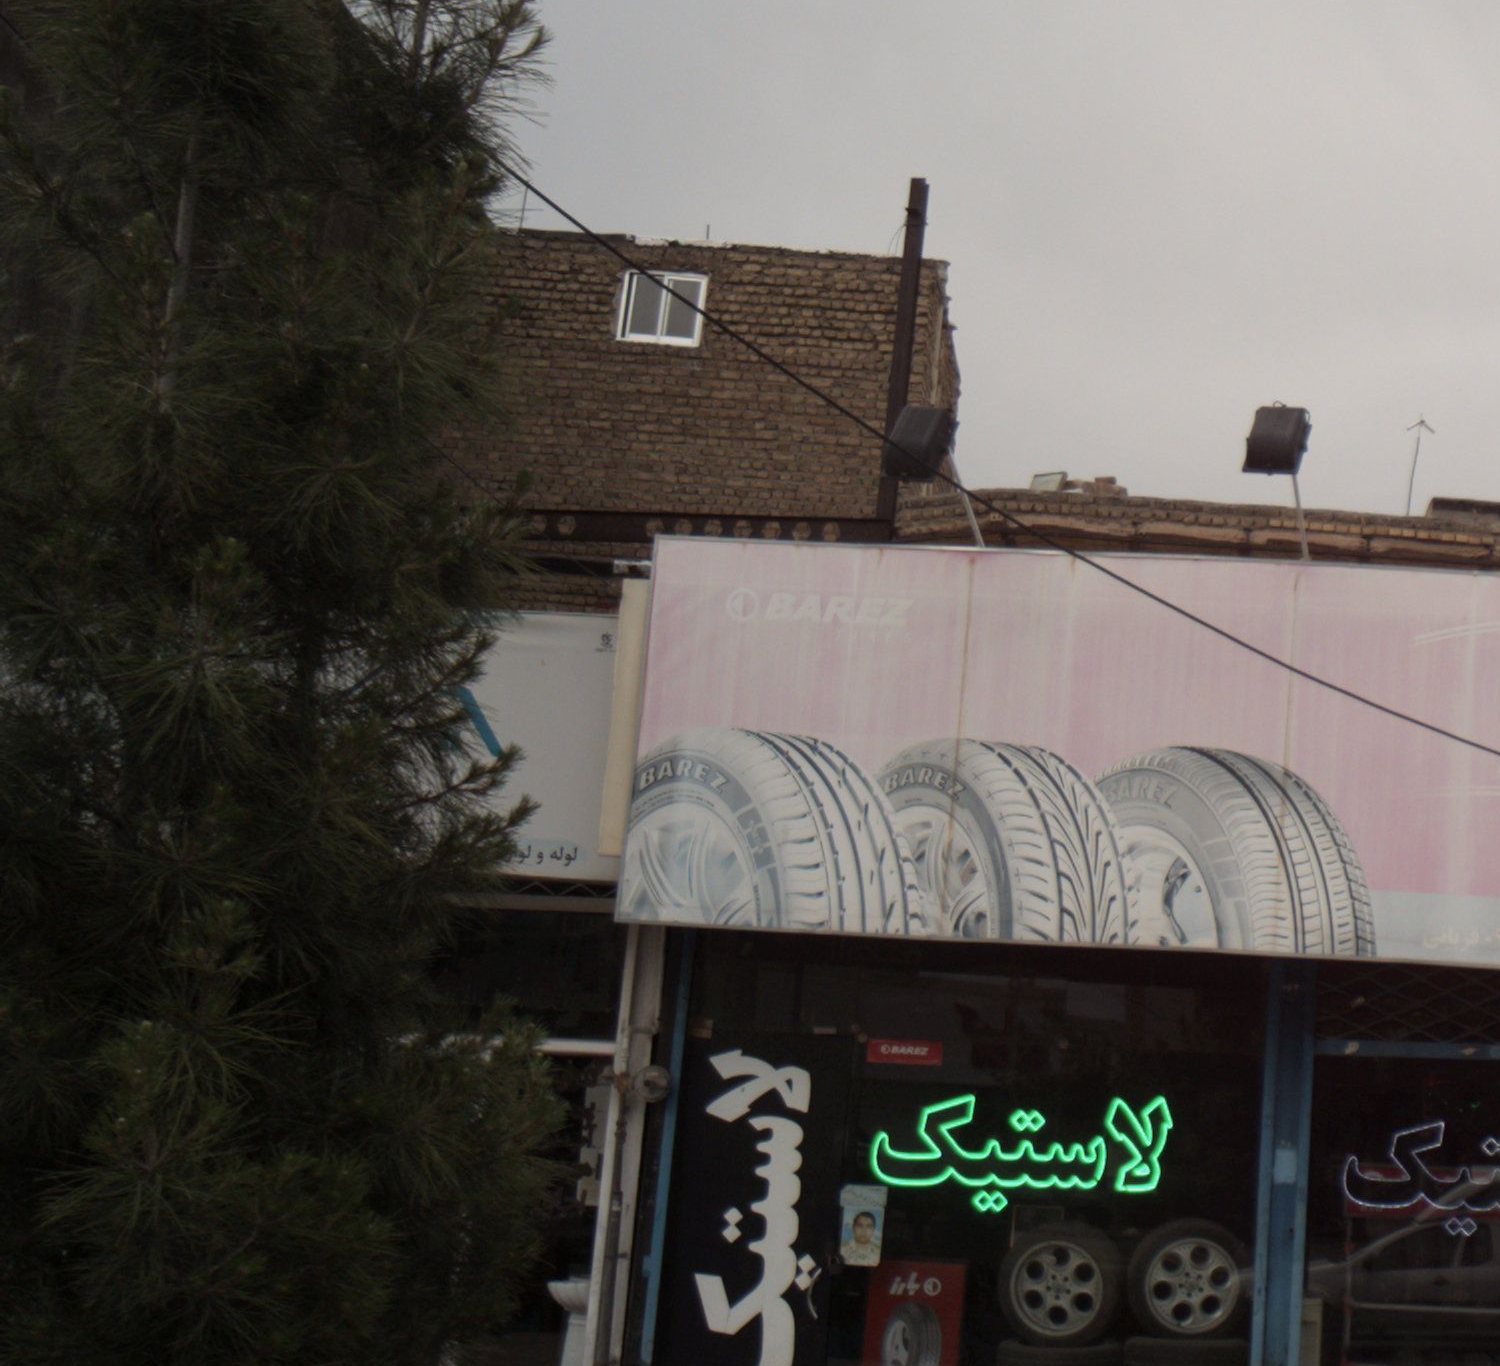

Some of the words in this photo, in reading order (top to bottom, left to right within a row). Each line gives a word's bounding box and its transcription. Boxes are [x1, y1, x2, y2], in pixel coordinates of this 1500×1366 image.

[763, 592, 914, 626] BAREZ
[638, 758, 727, 794] BAREZ
[886, 770, 967, 802] BAREZ
[1102, 776, 1178, 809] BAREZ
[550, 847, 577, 866] لوله
[891, 1045, 929, 1056] BAREZ
[870, 1094, 1173, 1213] لاستیک
